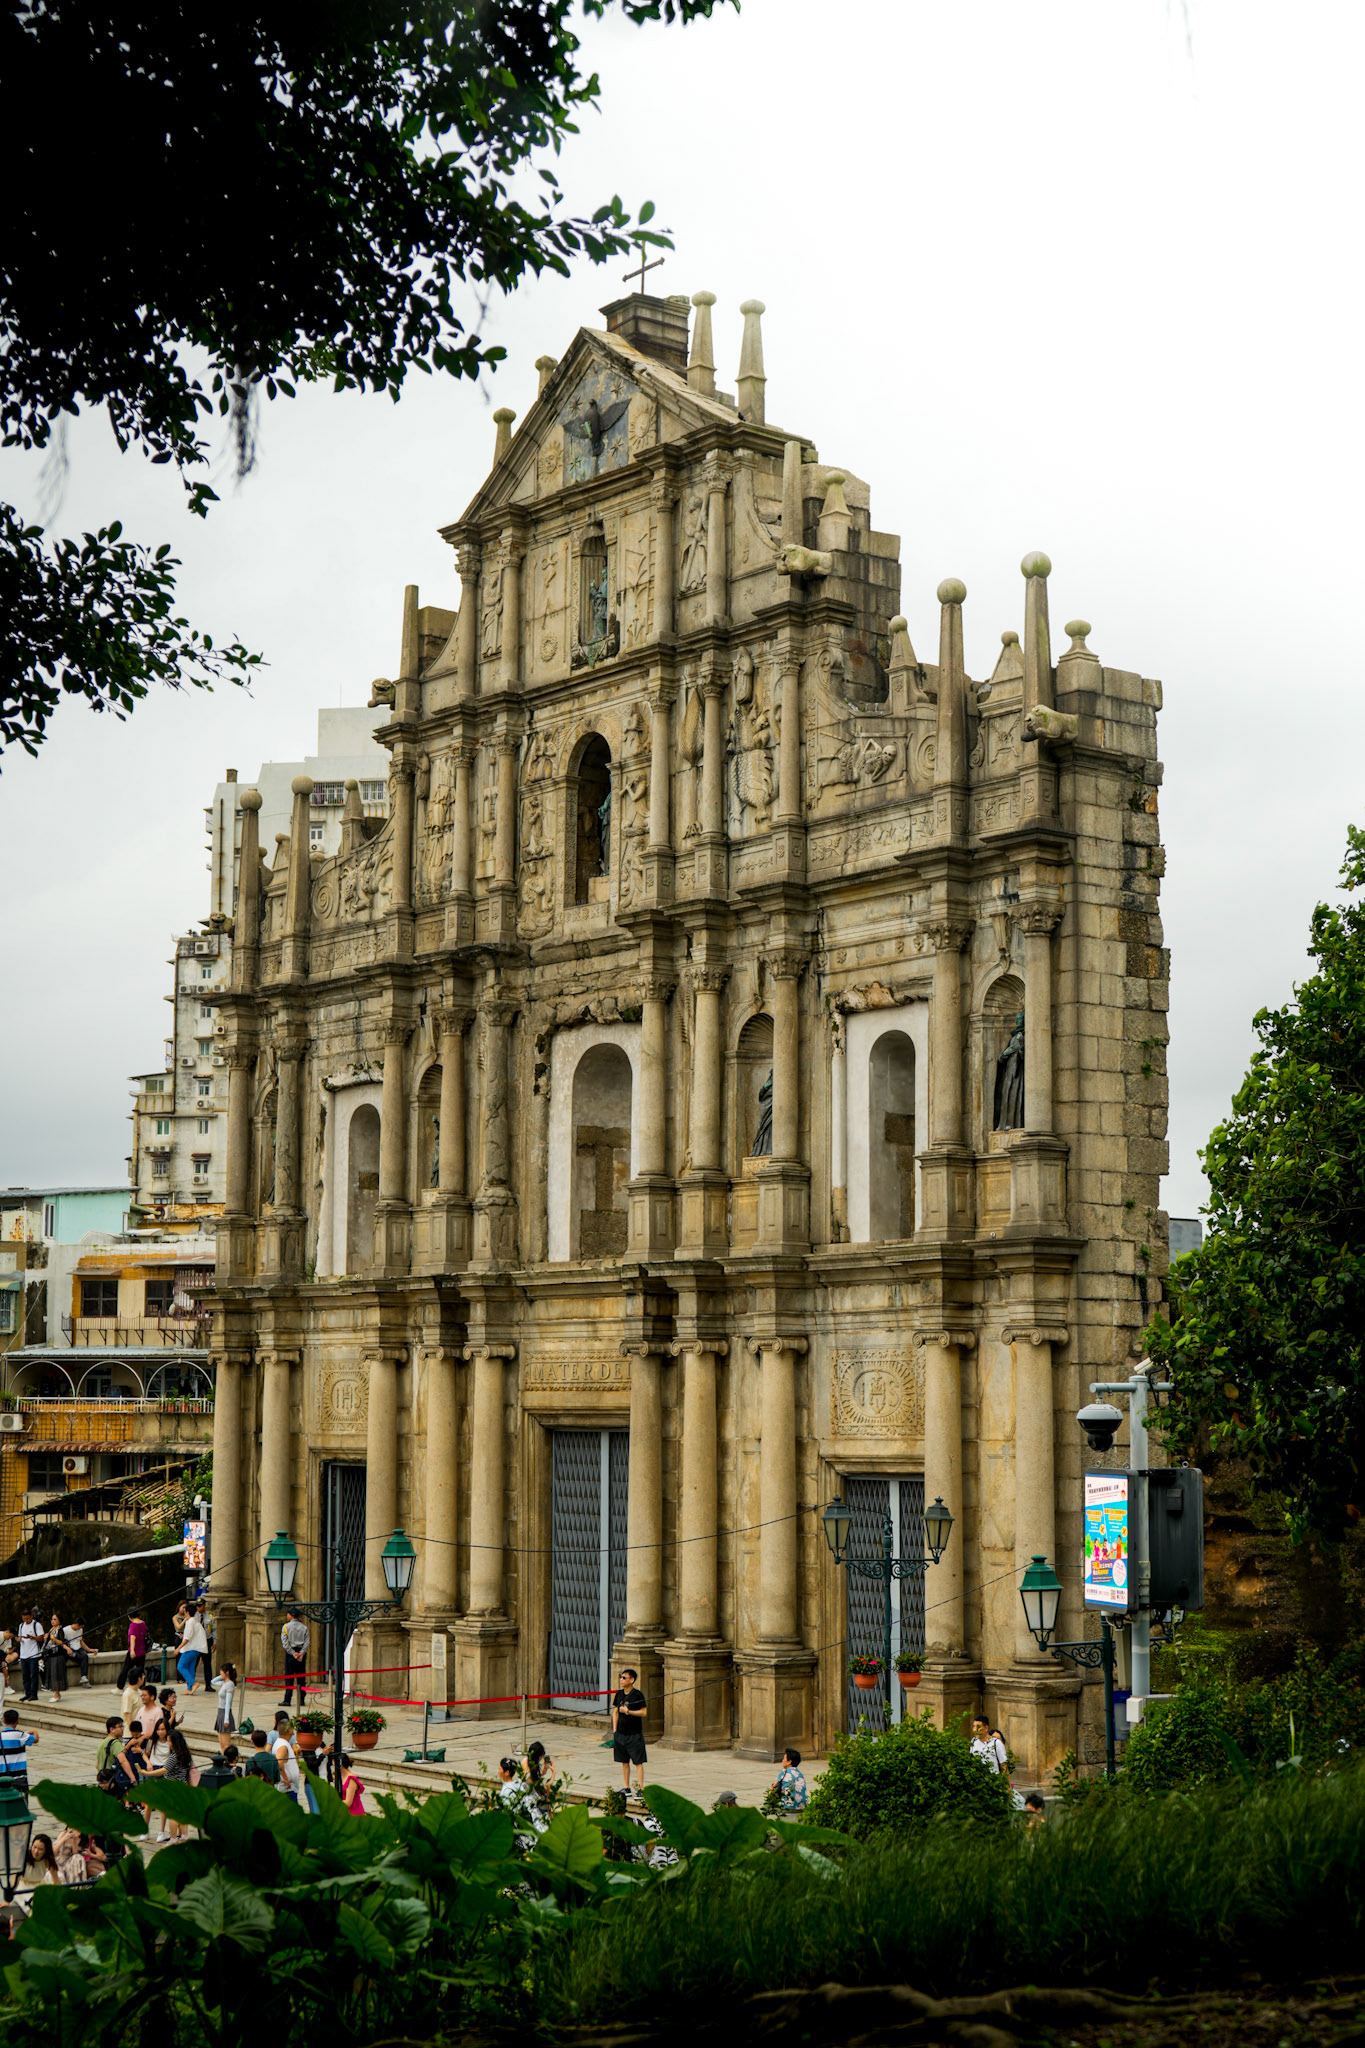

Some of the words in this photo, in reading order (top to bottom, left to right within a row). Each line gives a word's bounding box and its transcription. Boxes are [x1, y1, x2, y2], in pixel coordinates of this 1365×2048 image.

[529, 1361, 594, 1381] MATER
[336, 1386, 362, 1409] IHS
[860, 1380, 900, 1408] IHS
